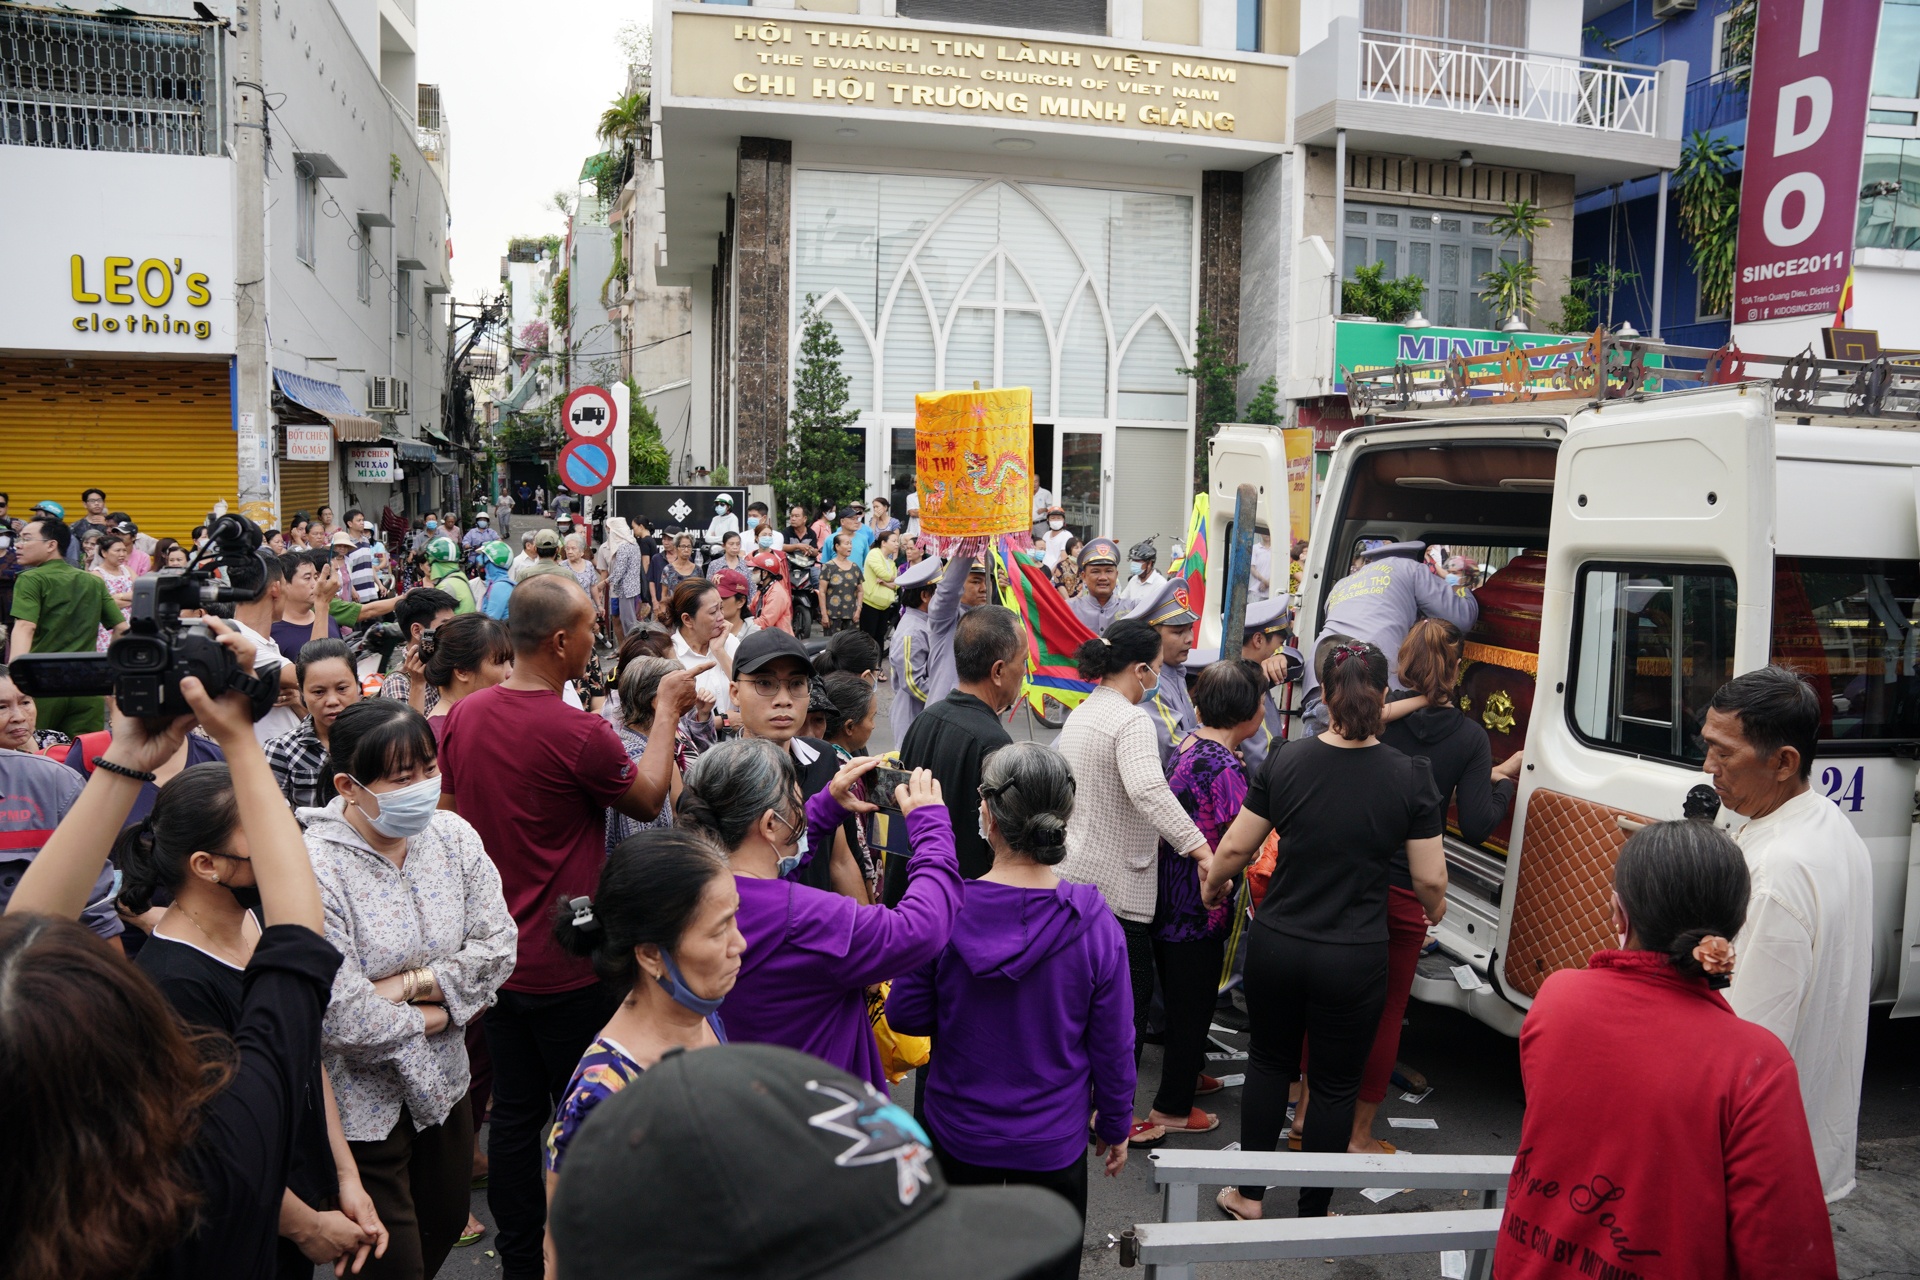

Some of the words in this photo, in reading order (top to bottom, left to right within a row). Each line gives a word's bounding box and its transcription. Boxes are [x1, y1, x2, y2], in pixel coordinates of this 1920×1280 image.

[734, 21, 791, 46] HỘI
[805, 29, 920, 53] THÁNH
[931, 39, 985, 59] TIN
[997, 42, 1081, 67] LÀNH
[1091, 54, 1162, 77] VIỆT
[1171, 61, 1237, 83] NAM
[757, 52, 804, 67] THE
[813, 55, 972, 80] EVANGELICAL
[980, 69, 1073, 88] CHURCH
[1080, 78, 1109, 91] OF
[1116, 81, 1165, 96] VIET
[1172, 86, 1220, 102] NAM
[733, 72, 796, 97] CHI
[812, 75, 875, 104] HỘI
[887, 83, 1029, 113] TRƯƠNG
[1039, 95, 1127, 122] MINH
[1138, 101, 1236, 132] GIẢNG
[70, 253, 211, 308] LEO's
[1742, 251, 1844, 283] SINCE2011
[1754, 295, 1768, 304] Tran
[1768, 292, 1790, 301] Quang
[1810, 285, 1834, 296] District
[1834, 284, 1840, 293] 3
[1774, 301, 1830, 315] KIDOSINCE2011
[72, 312, 211, 340] clothing
[1397, 334, 1510, 366] MINH
[354, 460, 369, 469] NUI
[1822, 765, 1866, 813] 24
[1554, 1237, 1579, 1267] BY
